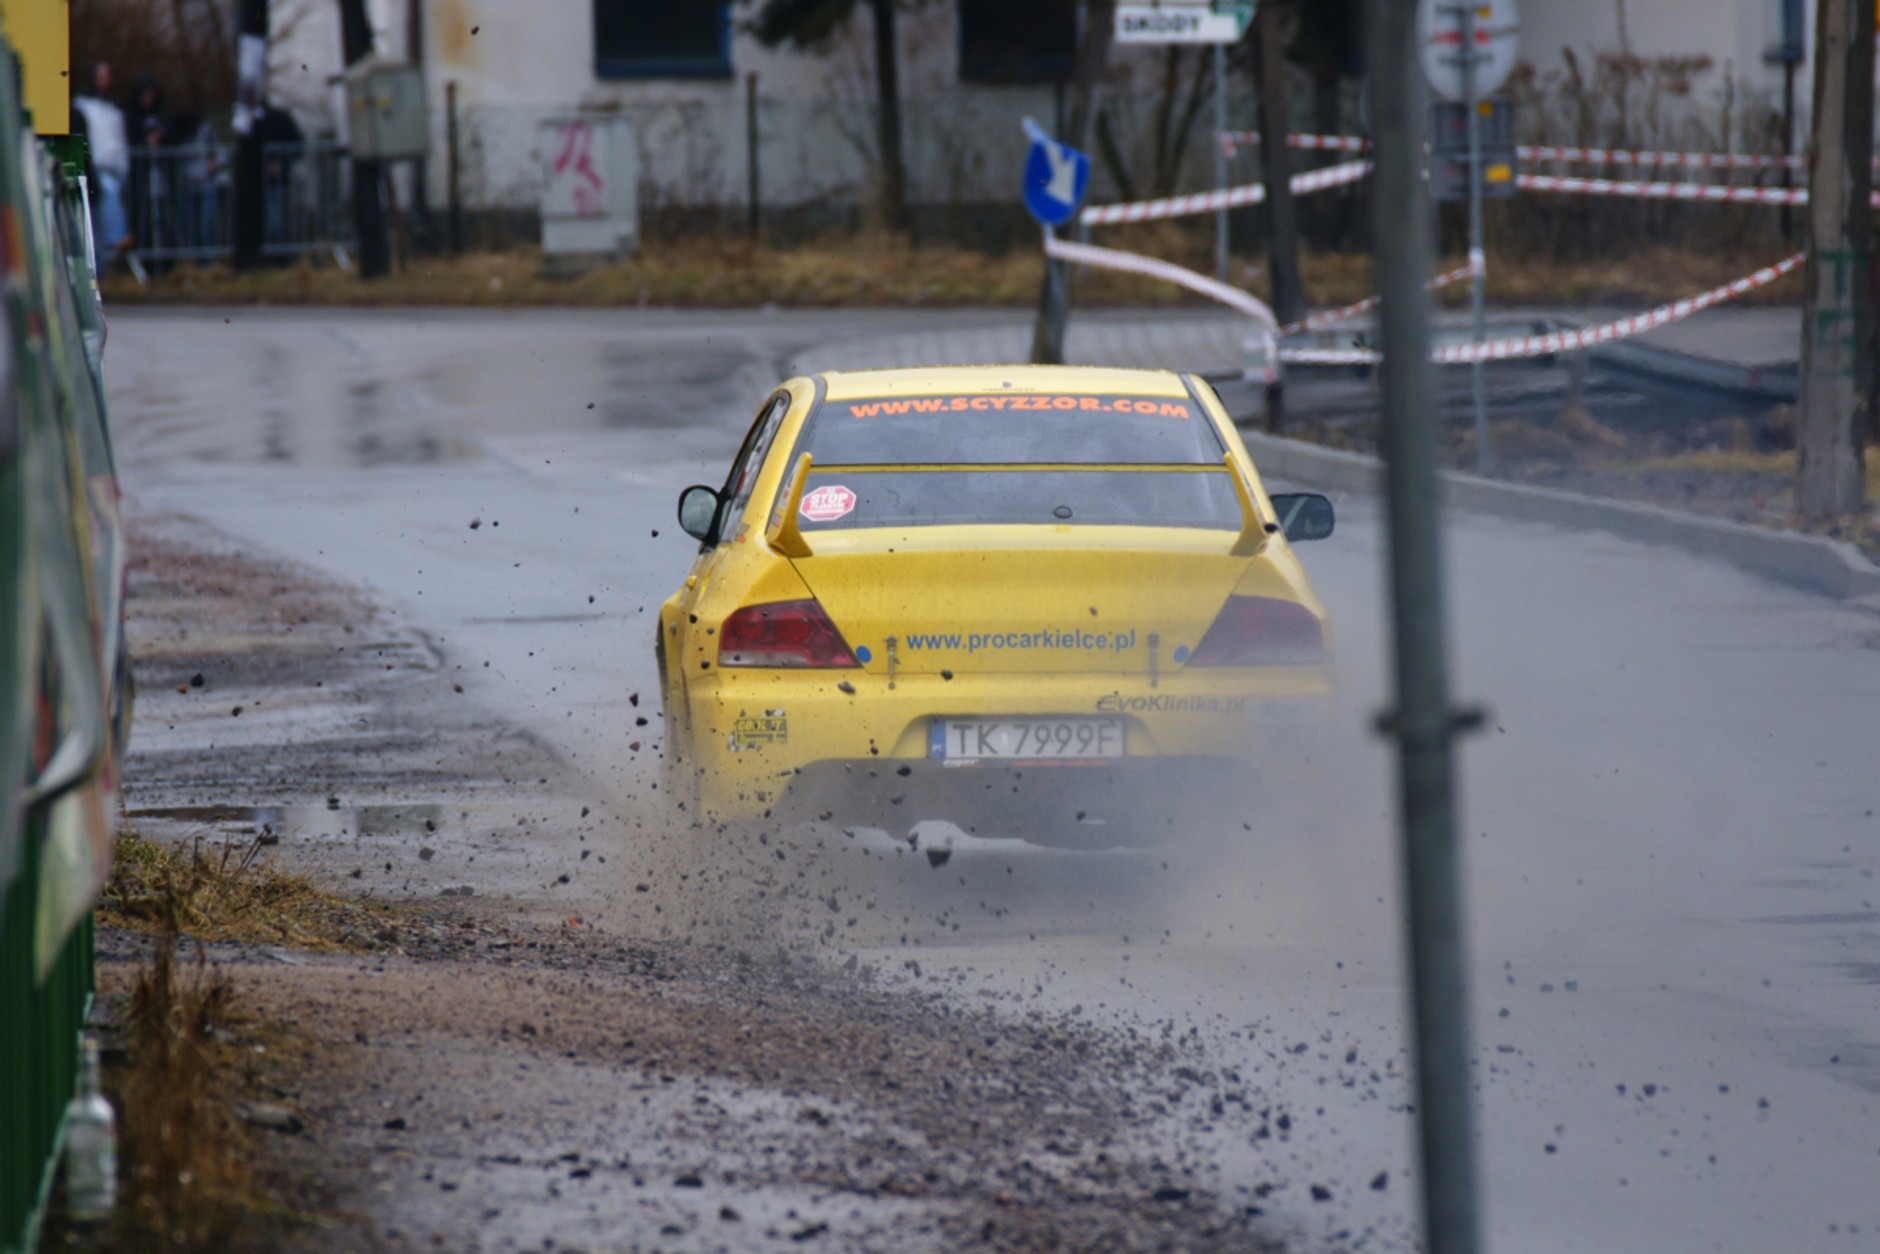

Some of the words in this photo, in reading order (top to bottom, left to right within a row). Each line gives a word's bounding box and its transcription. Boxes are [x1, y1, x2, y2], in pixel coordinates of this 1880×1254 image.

[849, 396, 1190, 419] WWW.SCYZZOR.COM
[810, 492, 849, 506] STOP
[906, 629, 1136, 652] www.procarkielce.pl
[1096, 694, 1245, 717] EvoKlinika.pl
[952, 724, 999, 755] TK
[1012, 723, 1116, 755] 7999F
